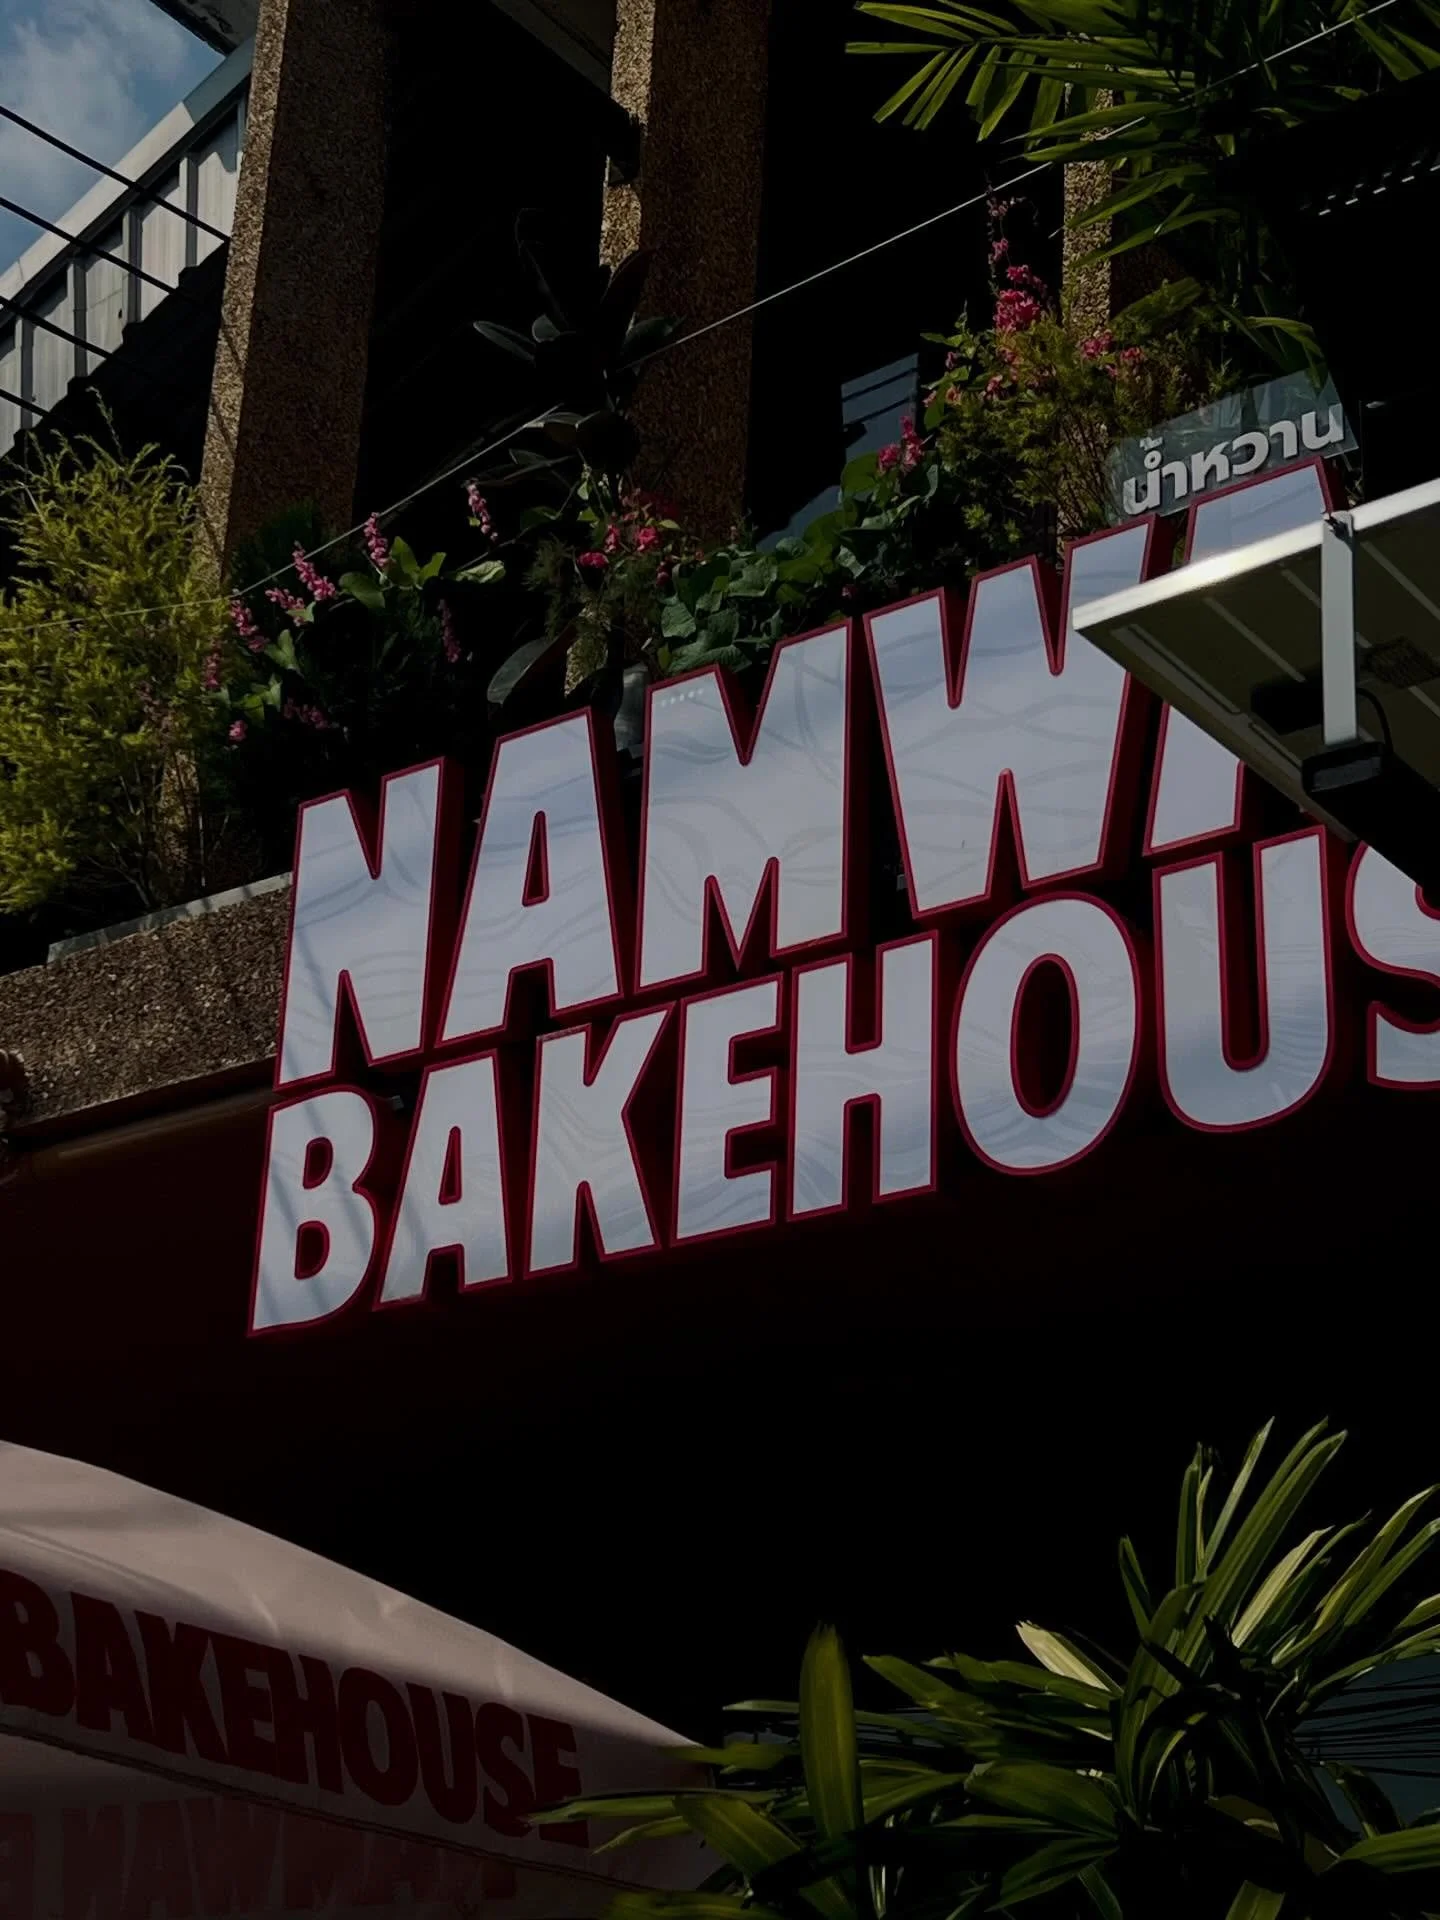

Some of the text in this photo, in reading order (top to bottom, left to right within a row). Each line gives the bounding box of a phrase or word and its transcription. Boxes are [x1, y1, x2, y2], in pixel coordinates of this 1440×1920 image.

[1122, 402, 1345, 516] น้ำหวาน
[0, 1569, 590, 1848] BAKEHOUSE
